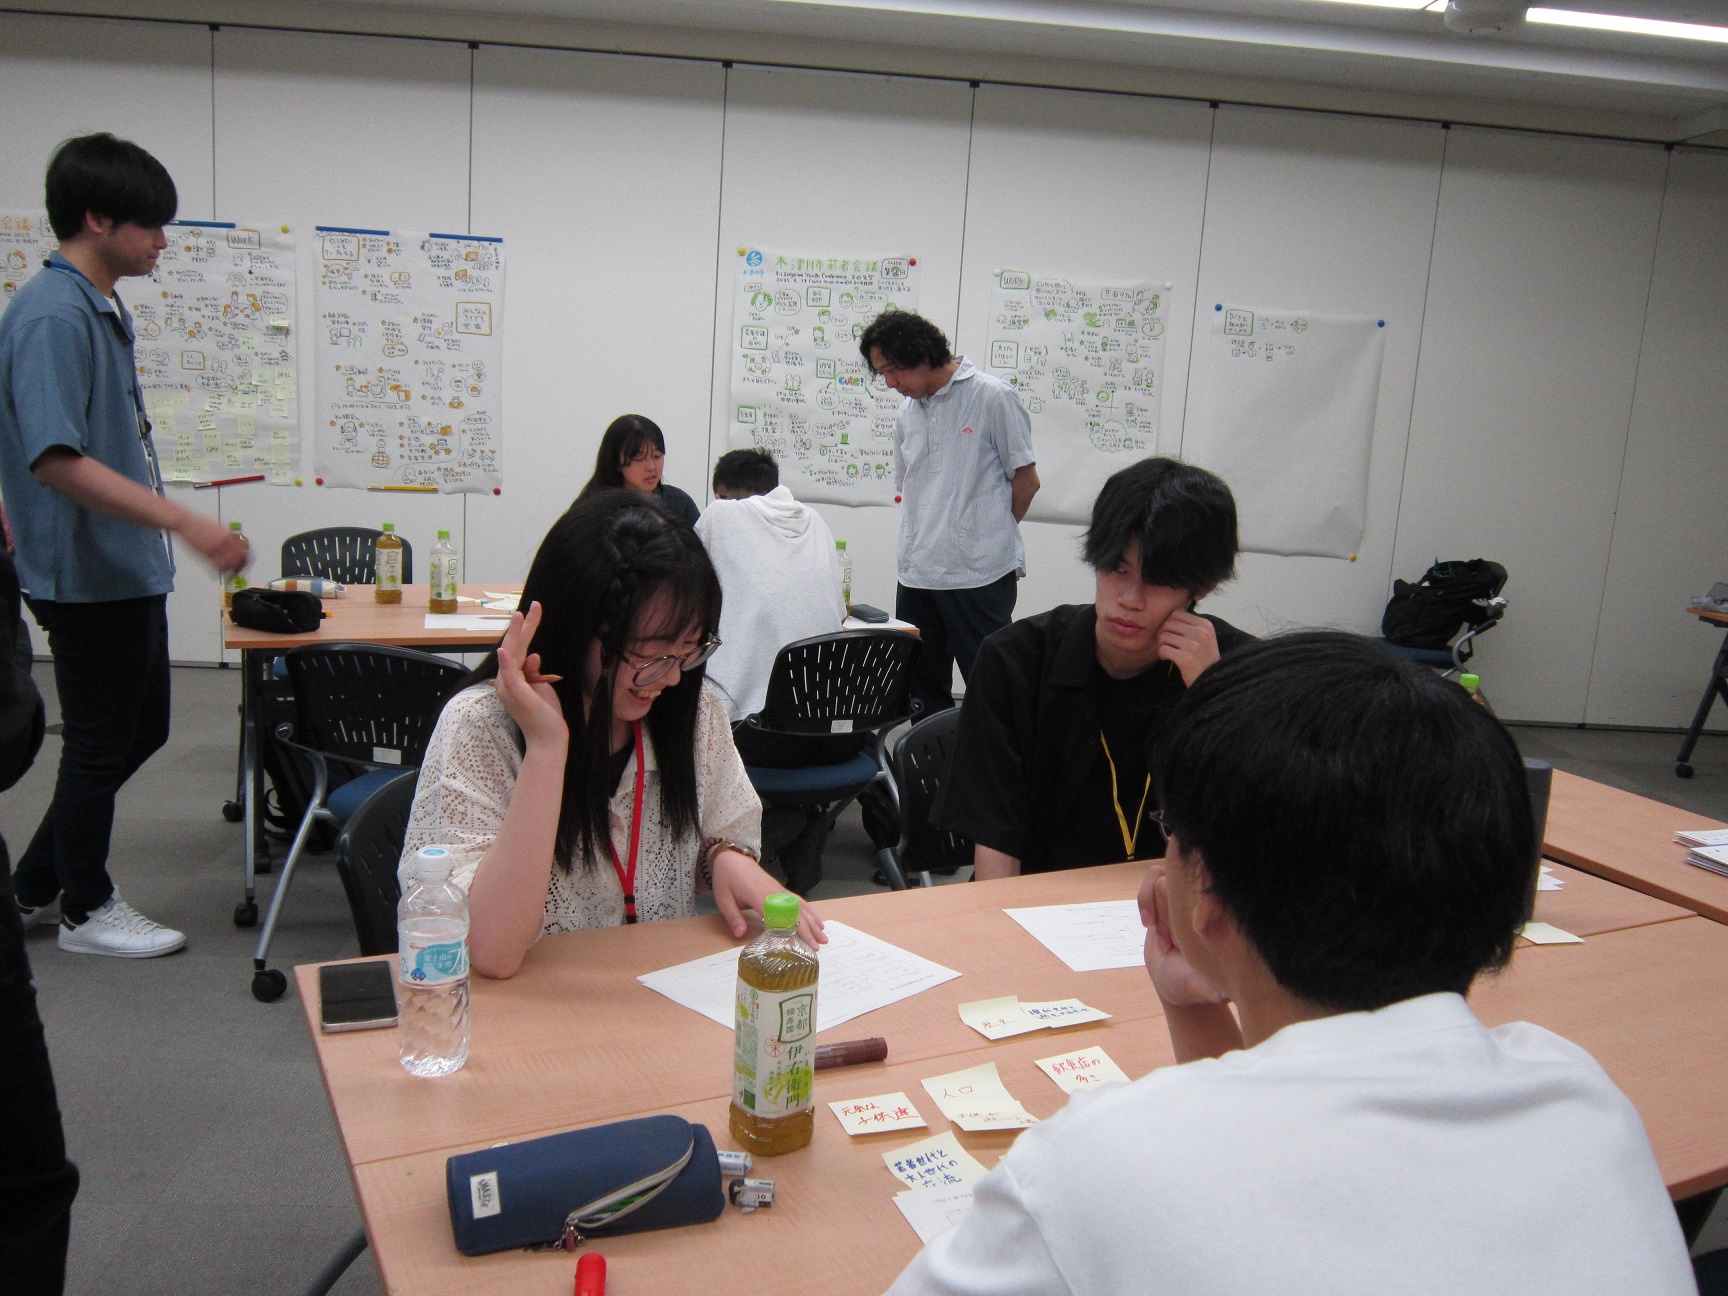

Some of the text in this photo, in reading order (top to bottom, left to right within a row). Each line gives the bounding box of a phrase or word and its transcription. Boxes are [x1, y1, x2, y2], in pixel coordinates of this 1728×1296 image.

[230, 234, 255, 245] Work
[775, 256, 878, 272] 木津川市若者会議
[1003, 276, 1025, 286] WORK
[838, 376, 864, 388] Cute!
[796, 1003, 808, 1031] 京都
[785, 1044, 804, 1110] 伊右衛門
[943, 1085, 973, 1099] 人口
[893, 1149, 948, 1173] 若者世代と
